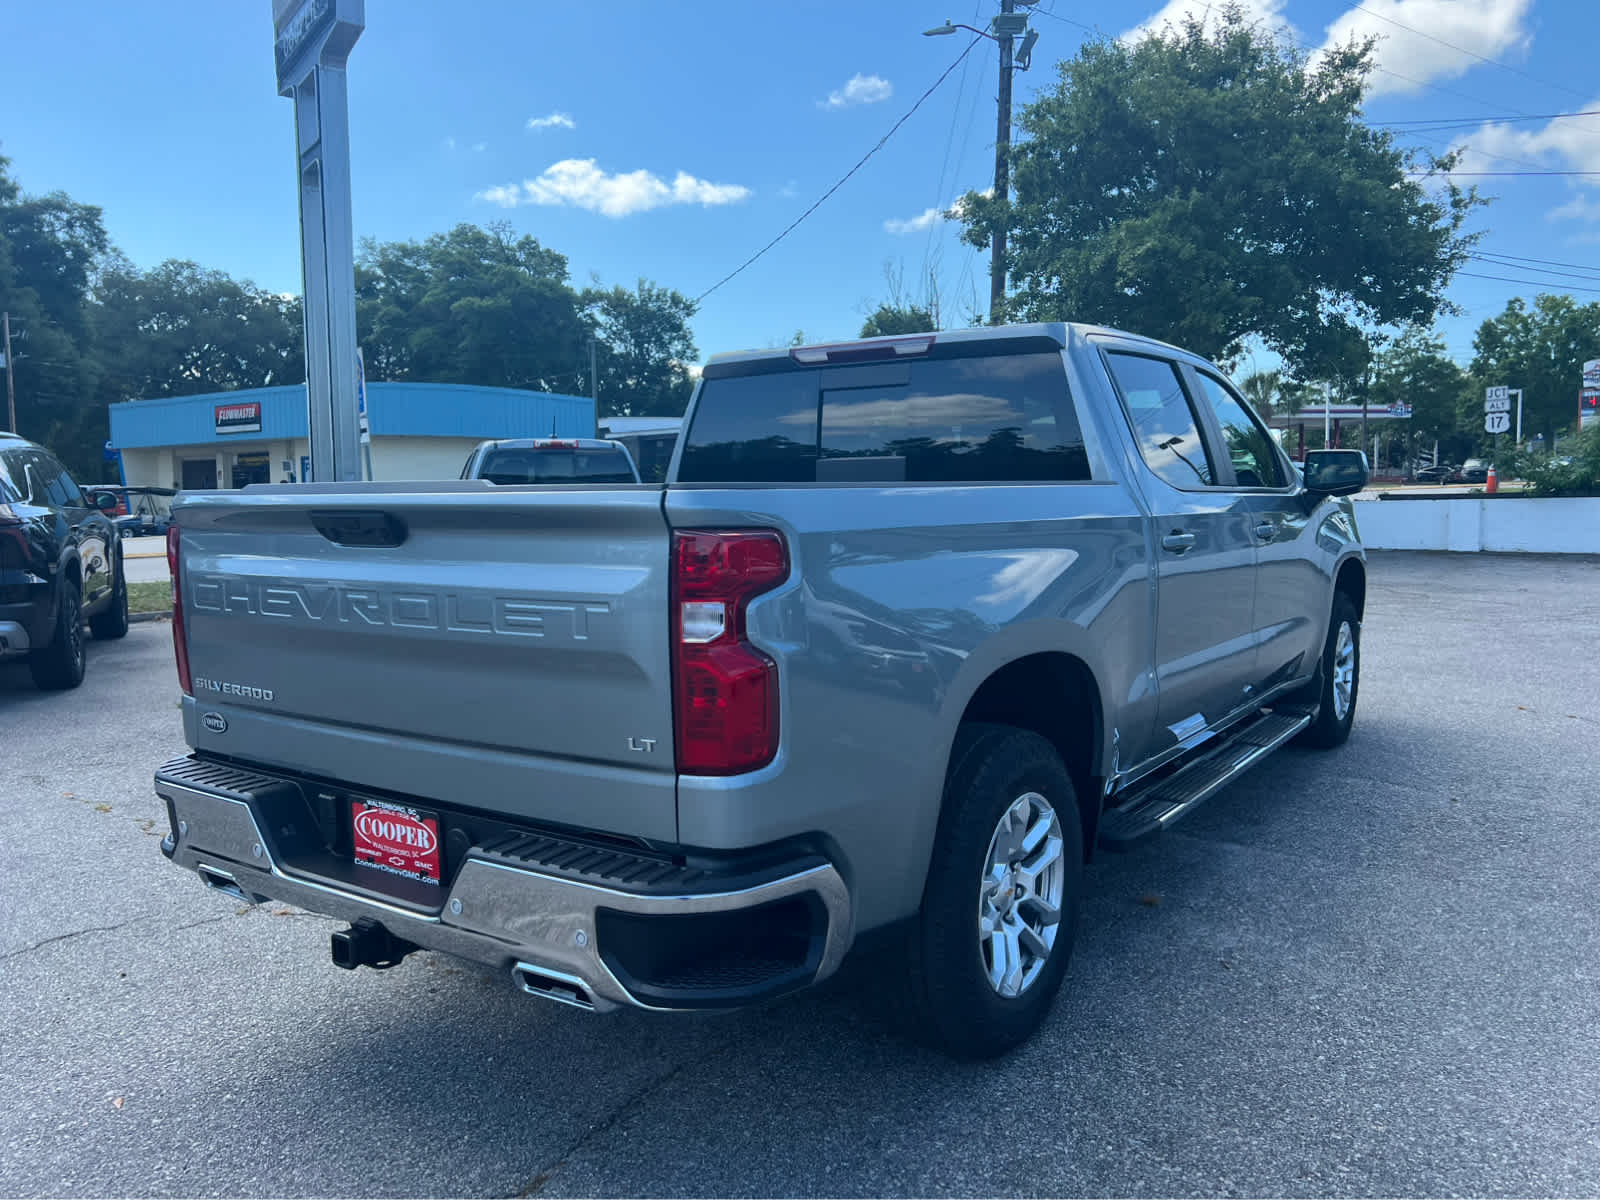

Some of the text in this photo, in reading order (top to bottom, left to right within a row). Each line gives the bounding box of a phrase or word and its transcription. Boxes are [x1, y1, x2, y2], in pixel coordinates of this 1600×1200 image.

[1488, 387, 1506, 399] JCT
[1491, 416, 1504, 429] 17
[193, 582, 614, 640] CHEVROLET
[195, 677, 273, 701] SILVERADO
[627, 737, 657, 752] LT
[360, 816, 430, 849] COOPER
[414, 860, 433, 871] GMC
